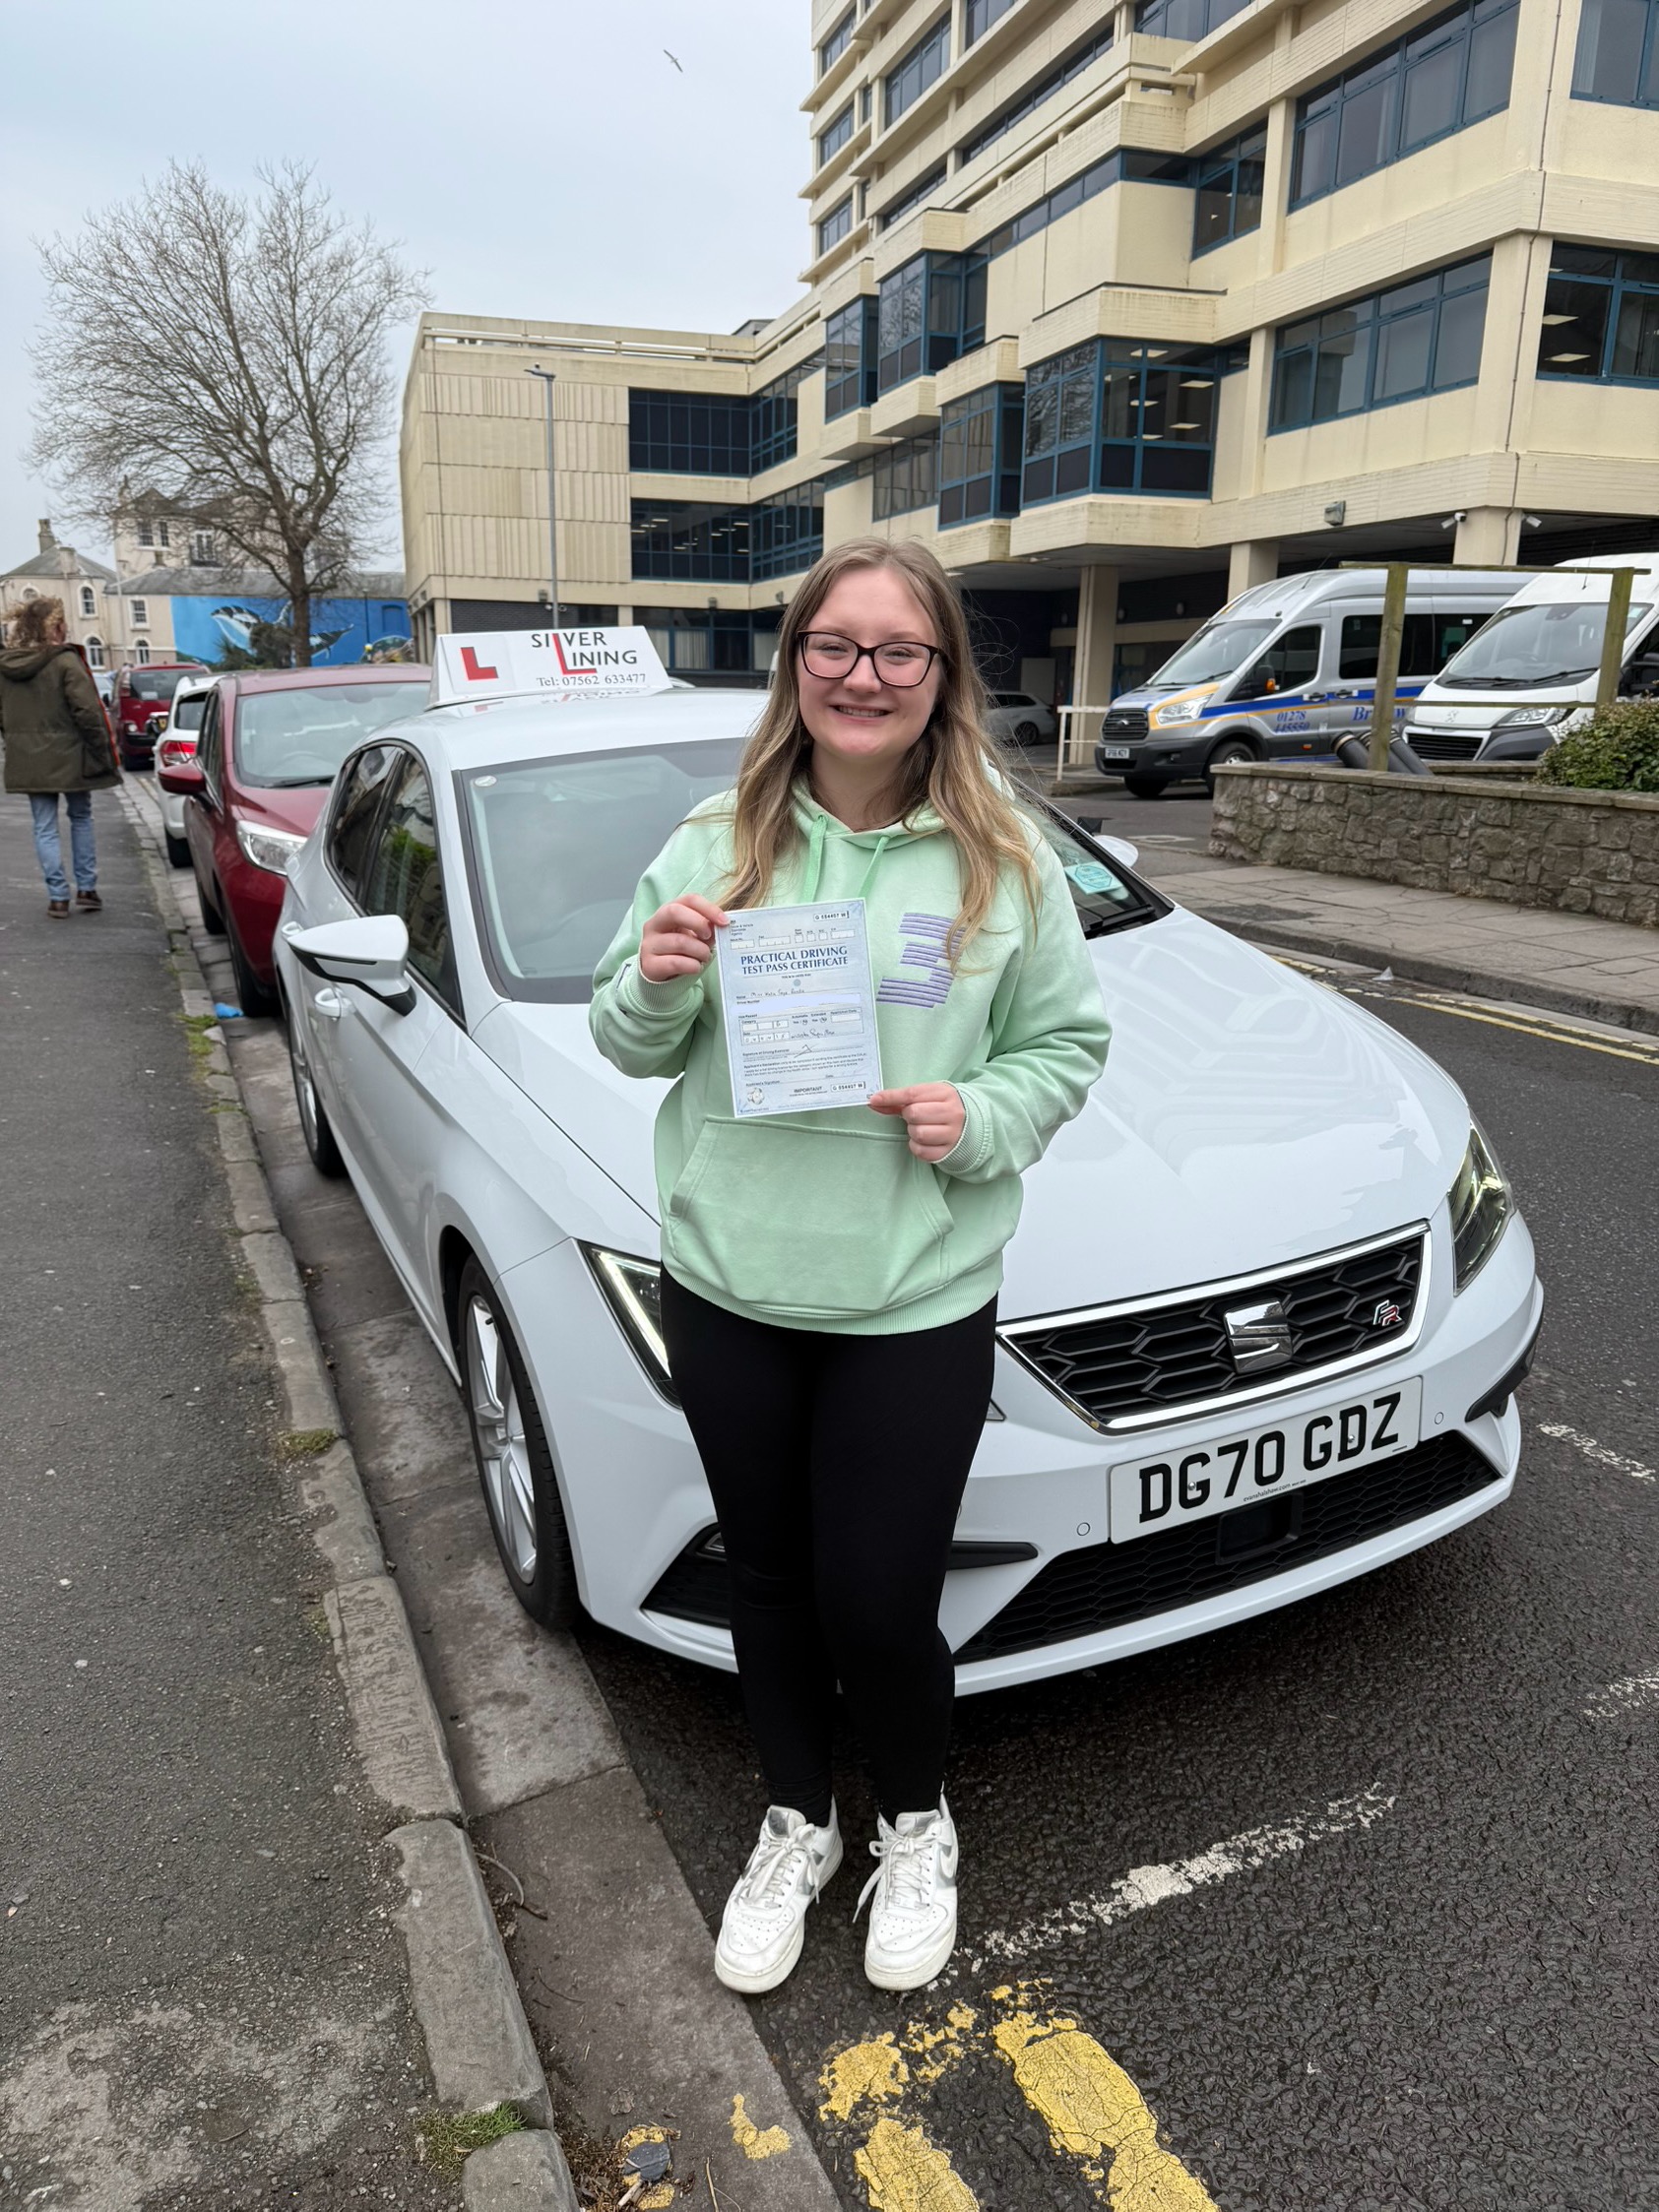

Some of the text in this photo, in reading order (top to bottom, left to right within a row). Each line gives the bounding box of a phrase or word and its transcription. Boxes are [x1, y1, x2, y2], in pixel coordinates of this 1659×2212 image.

[531, 631, 607, 650] SILVER
[460, 646, 499, 681] L
[536, 673, 647, 687] Tel: 07562 633477
[740, 946, 848, 966] PRACTICAL DRIVING
[742, 956, 849, 975] TEST PASS CERTIFICATE
[1138, 1391, 1402, 1524] DG70 GDZ
